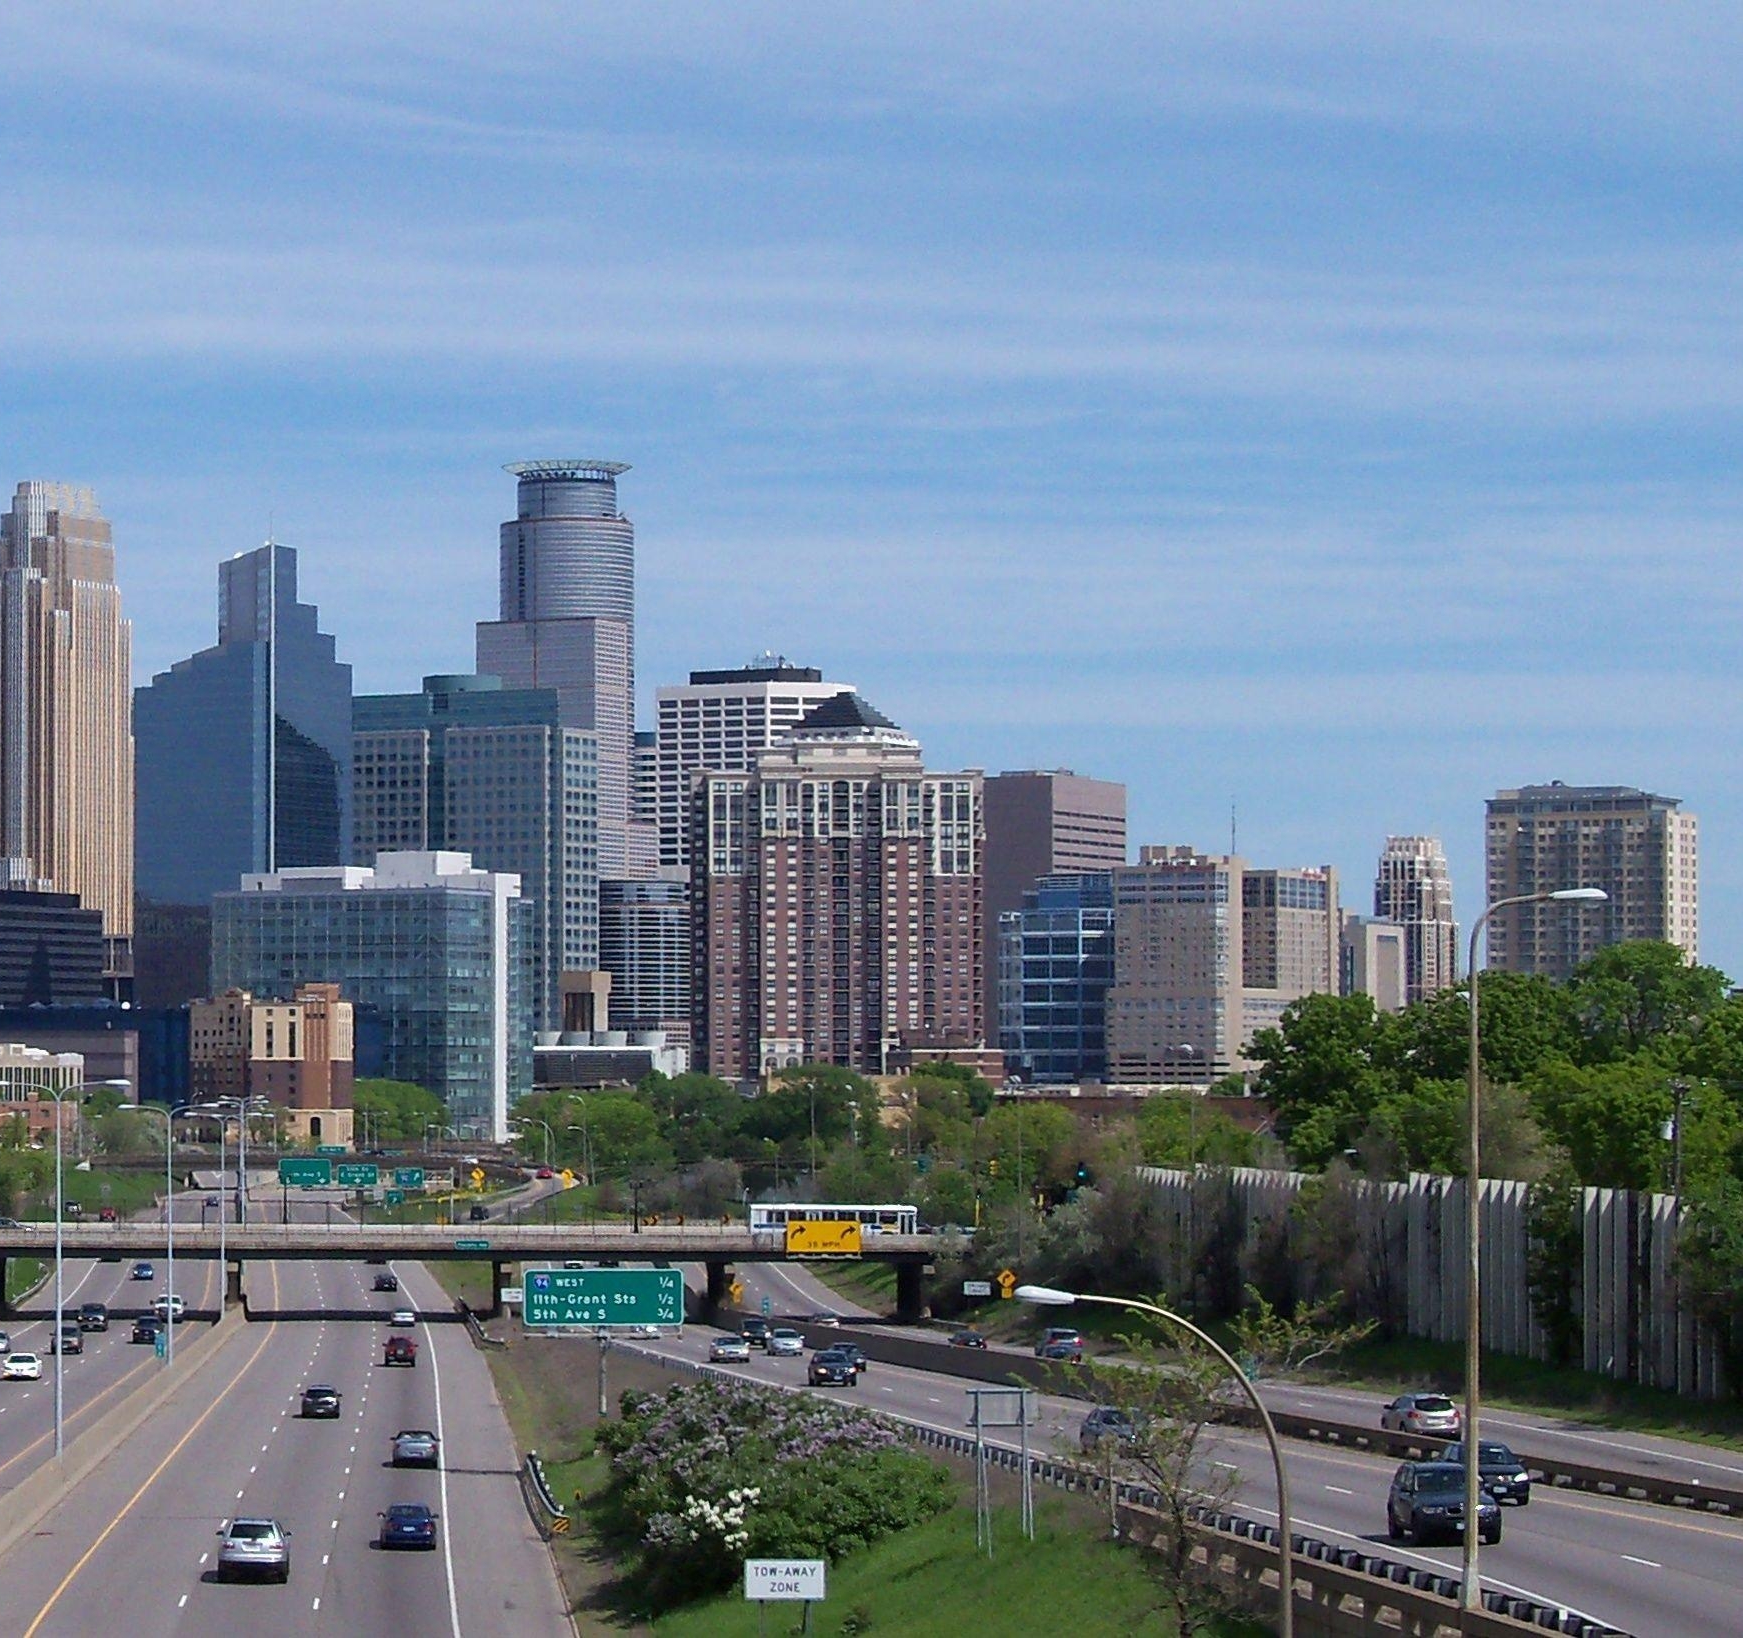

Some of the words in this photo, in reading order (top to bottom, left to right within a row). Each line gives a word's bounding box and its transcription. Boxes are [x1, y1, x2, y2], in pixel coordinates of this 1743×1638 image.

[535, 1280, 548, 1288] 94
[556, 1278, 584, 1287] WEST
[533, 1293, 607, 1304] 11th-Grant
[614, 1293, 637, 1304] Sts
[533, 1309, 557, 1319] 5th
[565, 1309, 590, 1319] Ave
[598, 1309, 607, 1319] S
[753, 1566, 816, 1577] TOW-AWAY
[770, 1582, 800, 1592] ZONE
